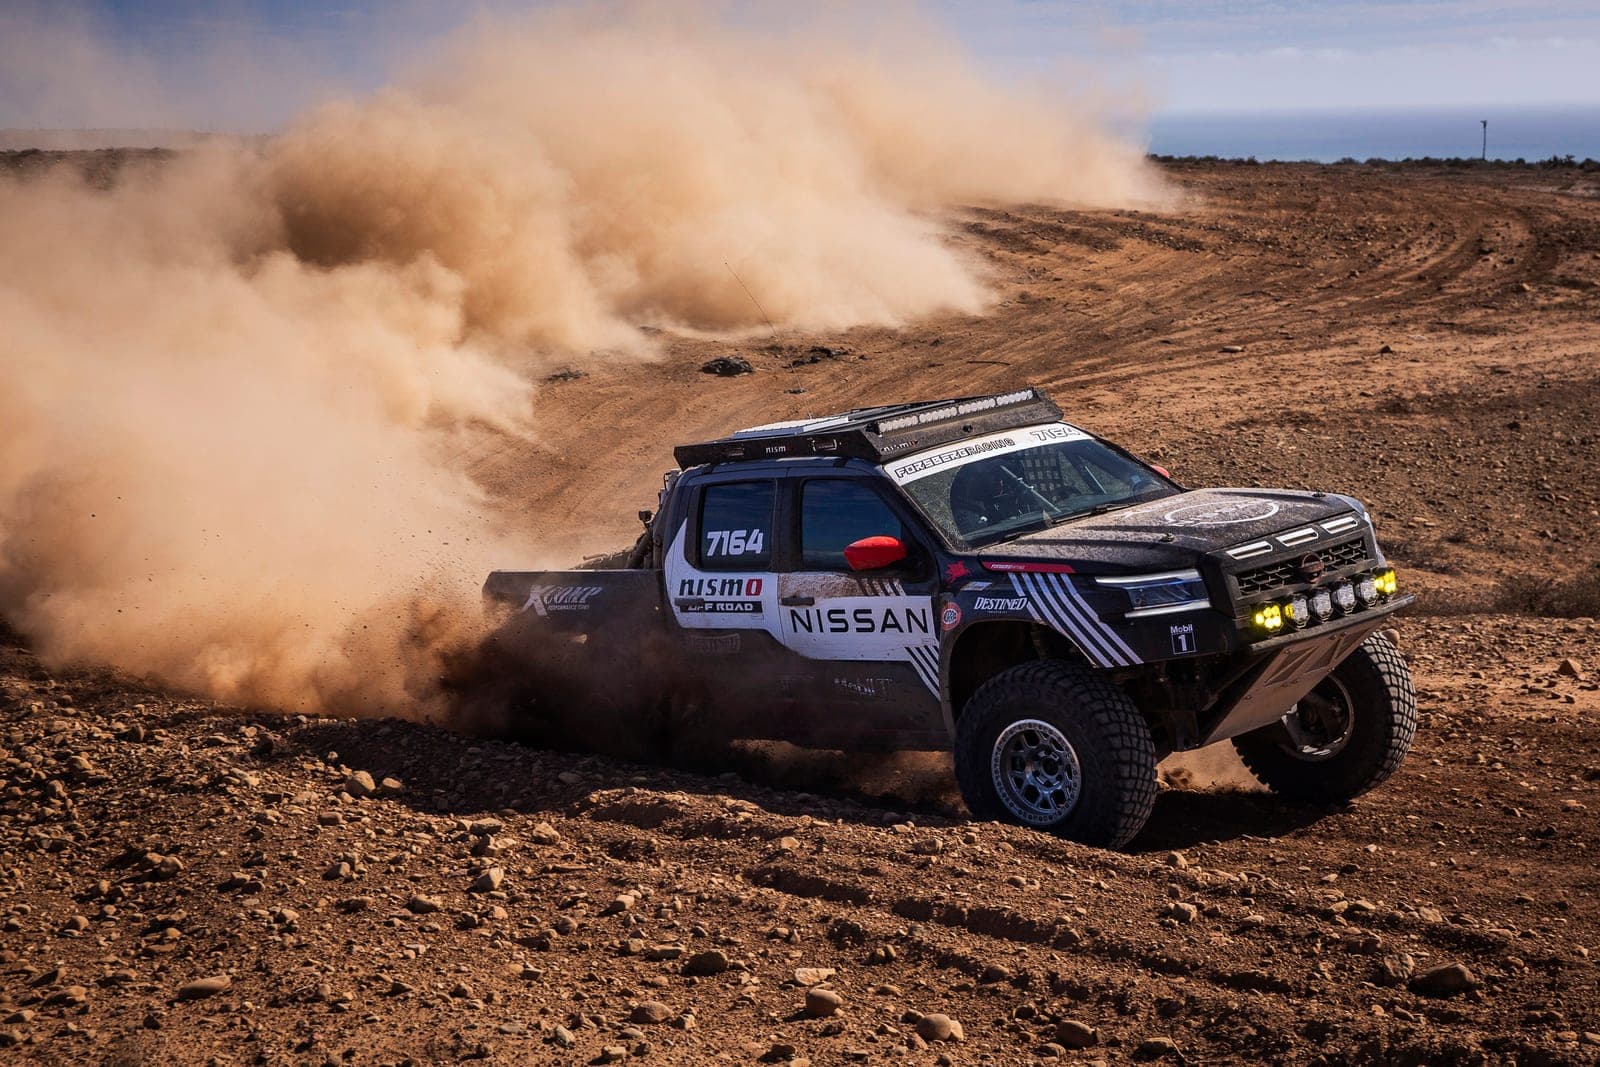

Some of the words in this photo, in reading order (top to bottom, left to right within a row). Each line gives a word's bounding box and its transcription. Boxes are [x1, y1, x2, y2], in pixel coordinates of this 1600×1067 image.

[1029, 427, 1081, 441] 7164
[765, 445, 793, 453] nism
[706, 528, 764, 556] 7164
[716, 603, 754, 611] ROAD
[974, 597, 1028, 611] DESTINED
[790, 608, 929, 633] NISSAN
[1170, 624, 1193, 634] Mobil
[1178, 634, 1188, 652] 1
